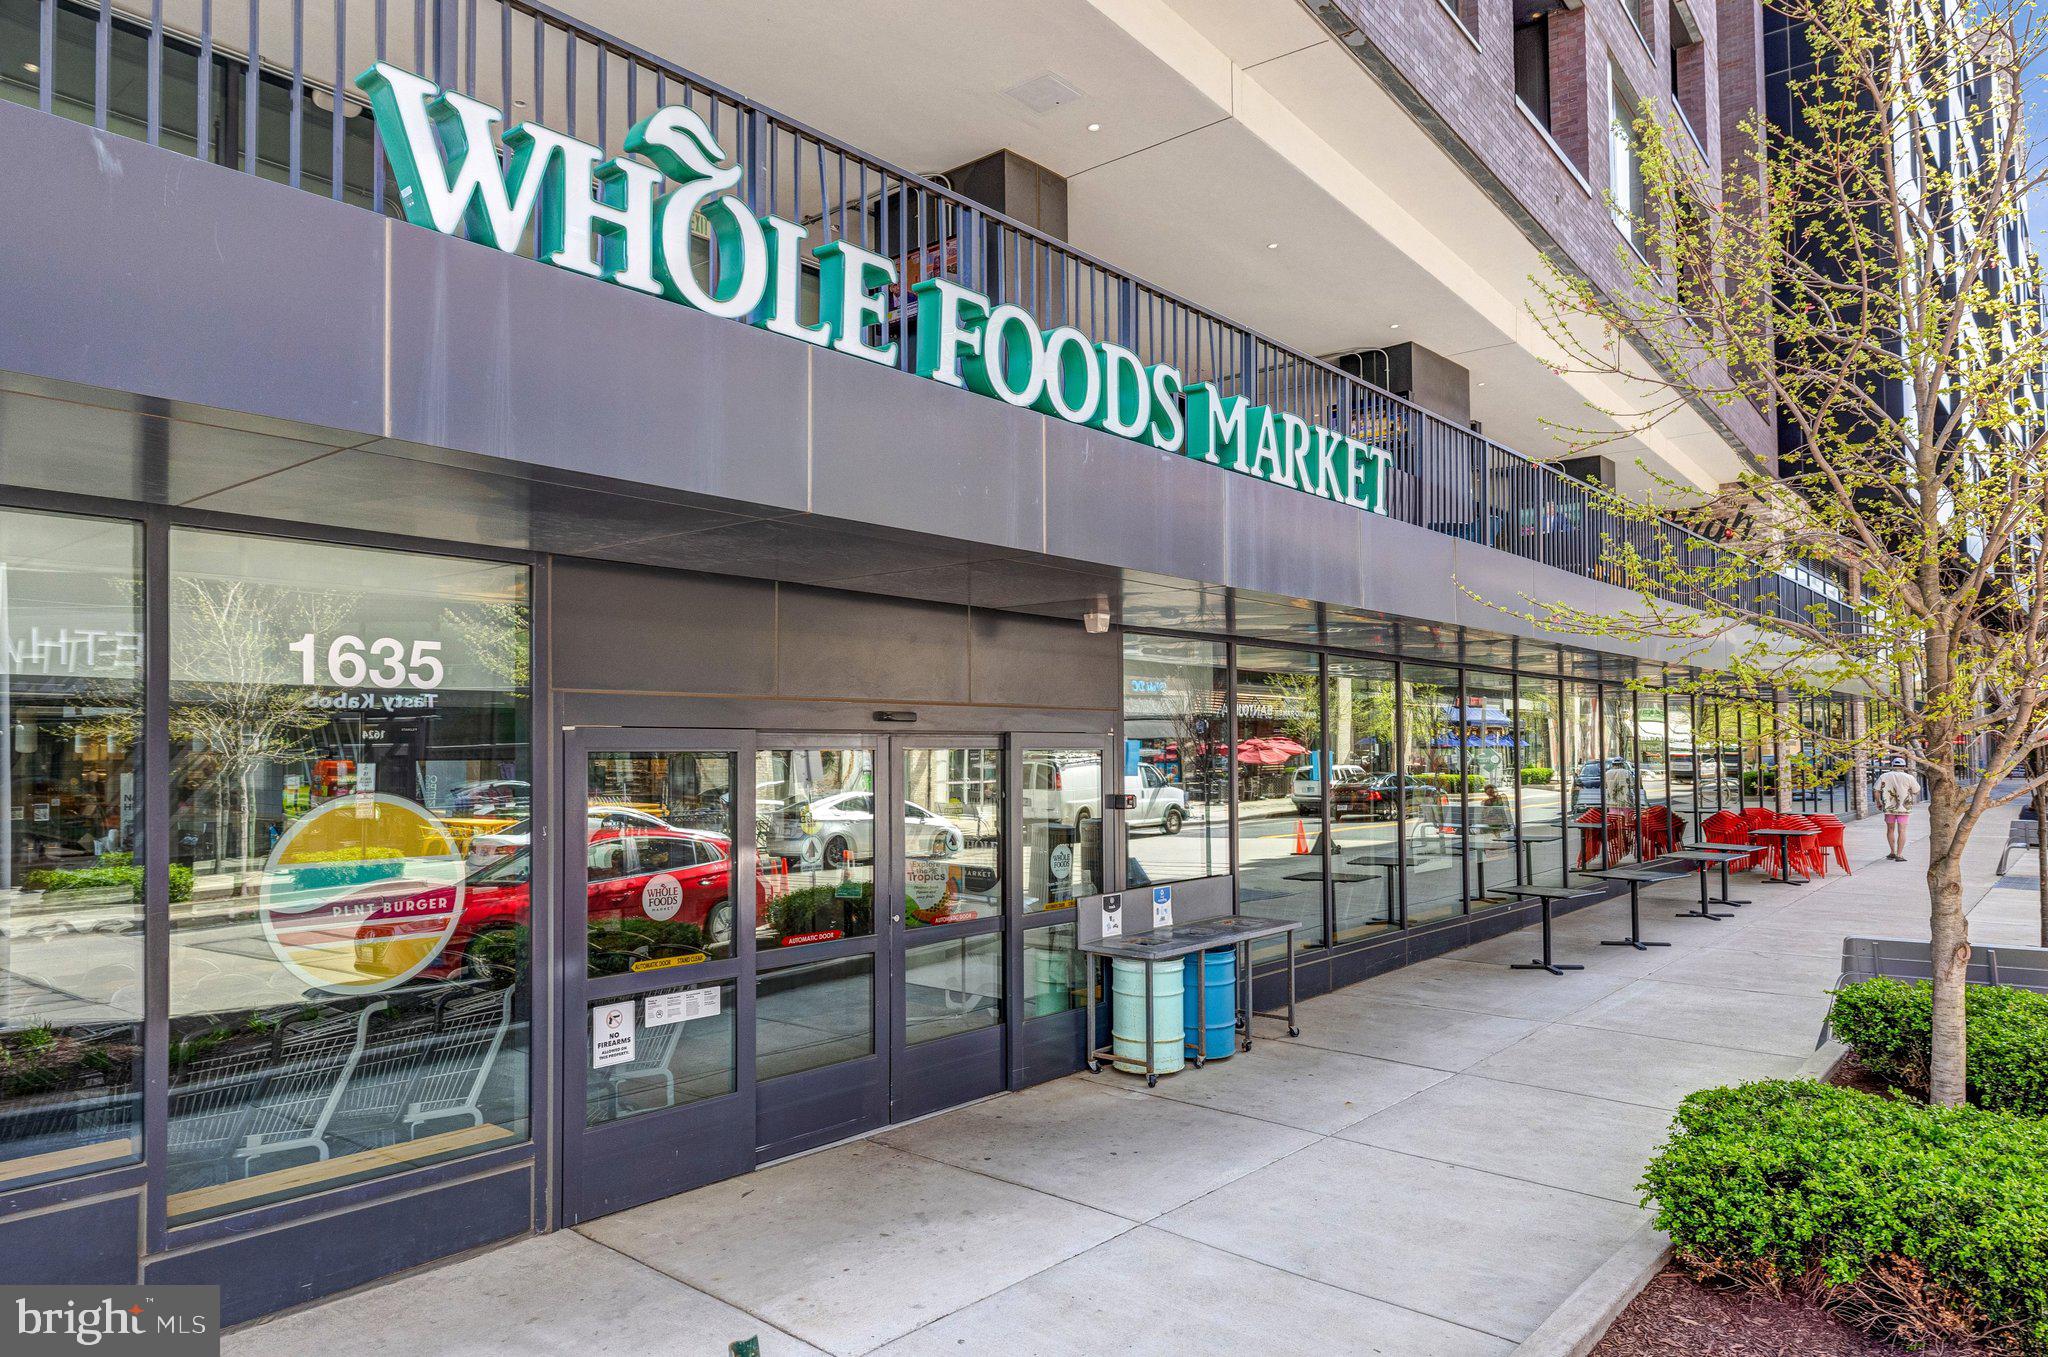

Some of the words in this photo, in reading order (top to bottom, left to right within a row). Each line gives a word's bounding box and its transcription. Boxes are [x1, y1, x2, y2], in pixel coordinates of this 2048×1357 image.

[356, 61, 898, 367] WHOLE
[914, 277, 1185, 452] FOODS
[1190, 381, 1393, 517] MARKET
[289, 634, 444, 689] 1635
[1053, 851, 1071, 862] WHOLE
[912, 860, 940, 869] Explore
[907, 872, 945, 883] Tropics
[966, 870, 992, 879] ARKET
[647, 884, 679, 898] WHOLE
[332, 904, 375, 917] PLNT
[383, 898, 447, 913] BURGER
[648, 896, 678, 907] FOODS
[788, 935, 818, 944] AUTOMATIC
[819, 932, 834, 940] DOOR
[634, 961, 659, 971] AUTOMATIC
[659, 959, 671, 967] DOOR
[597, 1037, 631, 1049] FIREARMS
[601, 1047, 620, 1055] ALLOWED
